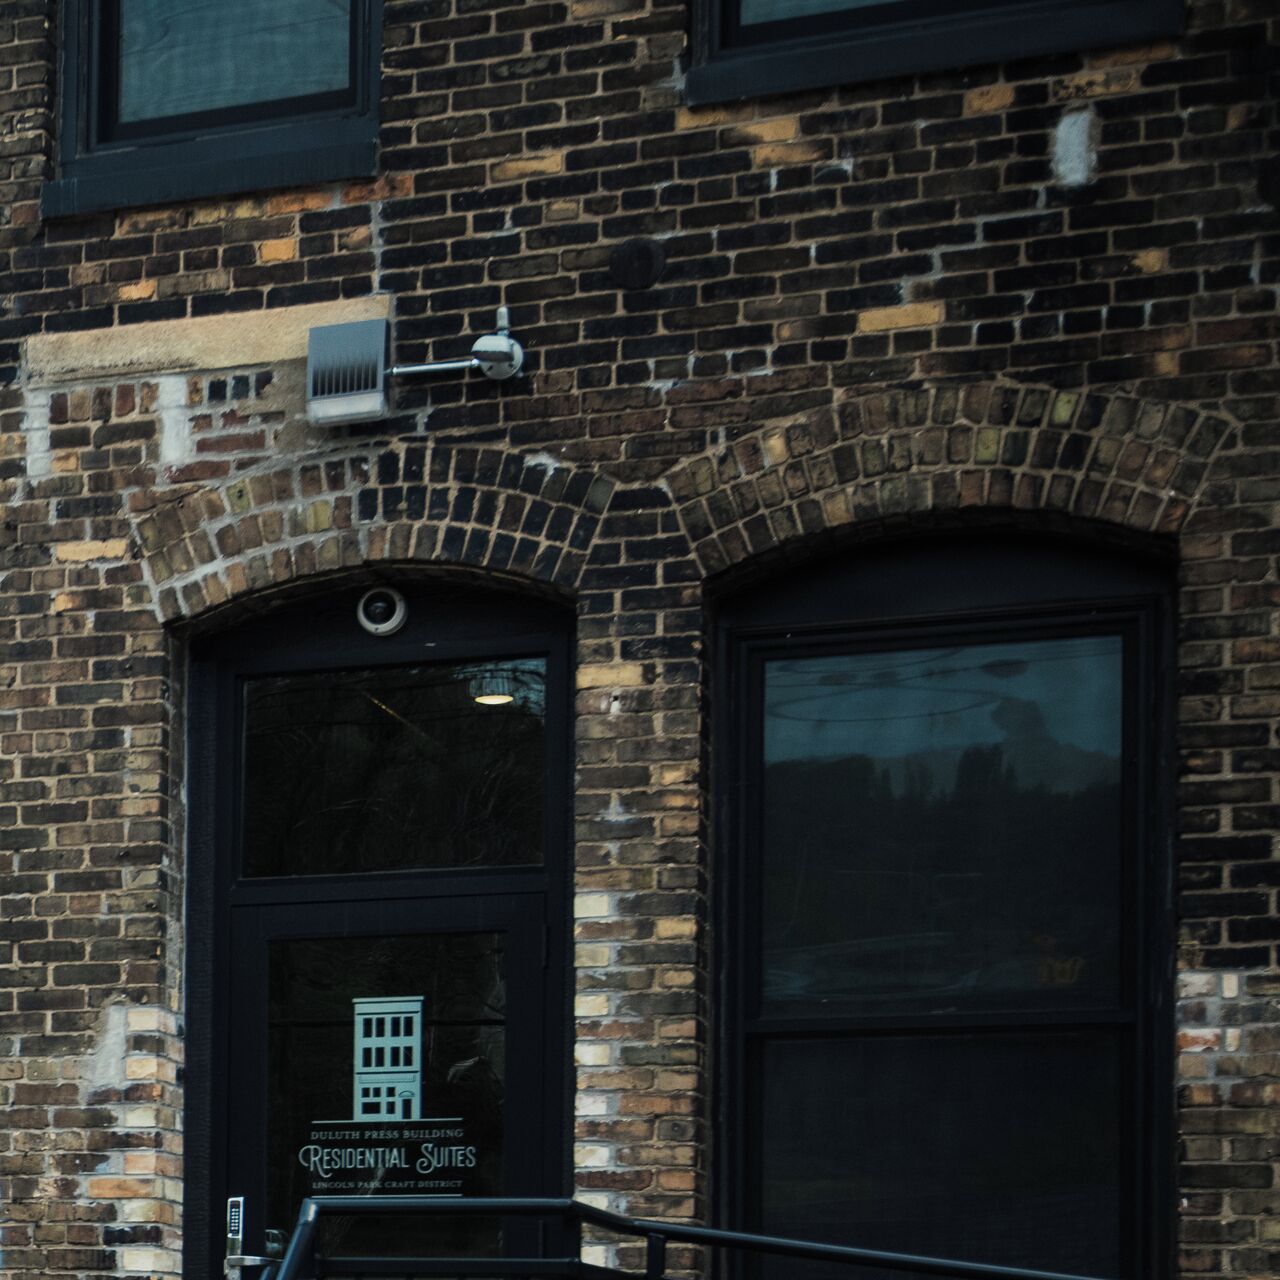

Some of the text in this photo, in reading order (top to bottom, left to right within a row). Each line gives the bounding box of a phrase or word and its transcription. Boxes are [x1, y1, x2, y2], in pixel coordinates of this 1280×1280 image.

[311, 1129, 464, 1140] DULUTH PRESS BUILDING
[312, 1181, 355, 1189] LINCOLN
[357, 1181, 383, 1189] PARK
[418, 1180, 463, 1188] DISTRICT
